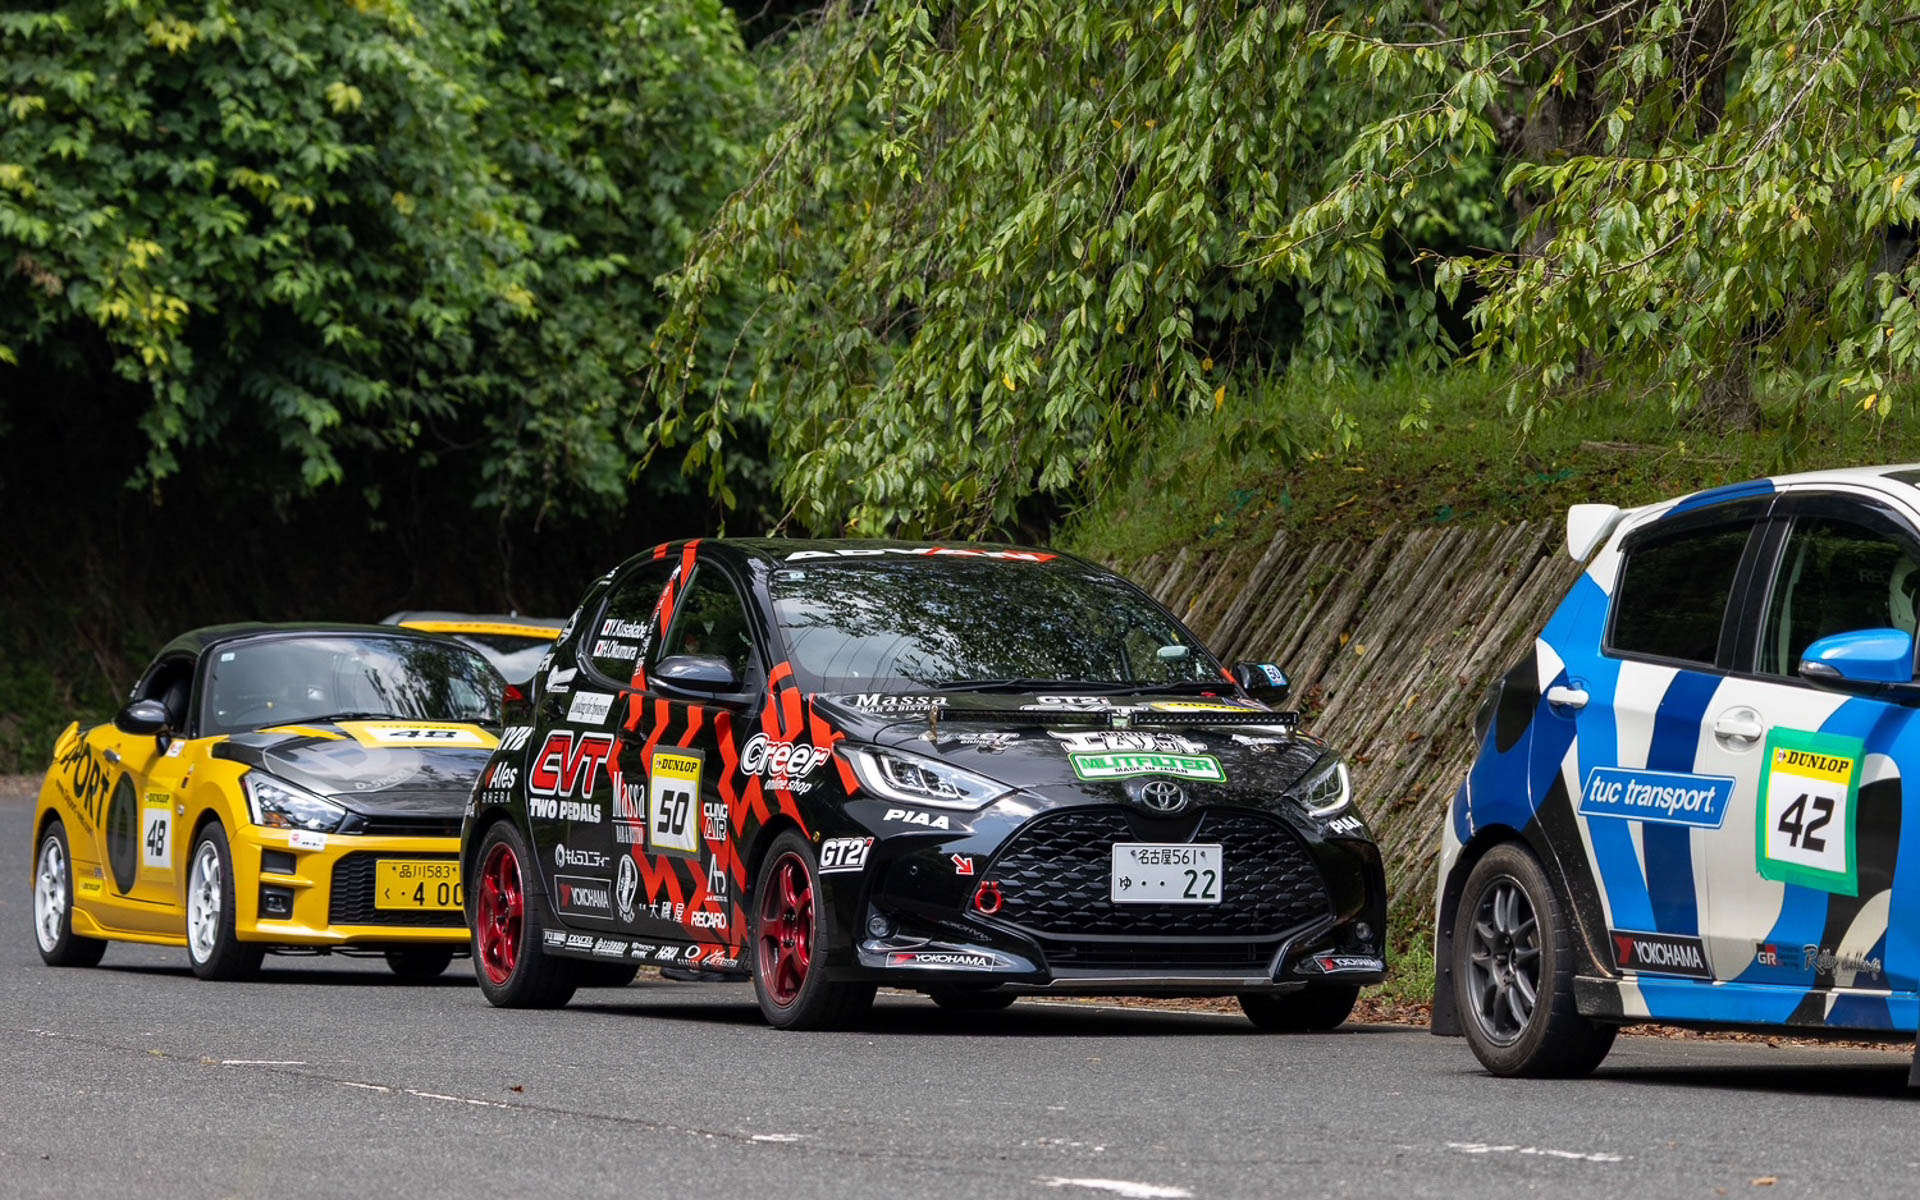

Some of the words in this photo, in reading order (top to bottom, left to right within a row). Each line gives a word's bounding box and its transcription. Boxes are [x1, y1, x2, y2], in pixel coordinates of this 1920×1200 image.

[855, 693, 950, 707] Massa
[661, 758, 698, 773] DUNLOP
[741, 733, 831, 778] Creer
[1787, 751, 1849, 774] DUNLOP
[1158, 766, 1189, 774] JAPAN
[612, 771, 646, 819] Massa
[764, 778, 786, 791] online
[786, 779, 812, 795] shop
[1589, 775, 1622, 803] tuc
[1625, 778, 1716, 816] transport
[529, 798, 557, 819] TWO
[559, 801, 601, 823] PEDALS
[657, 789, 690, 836] 50
[703, 802, 728, 818] CLING
[883, 808, 949, 830] PIAA
[703, 817, 727, 841] AIR
[1778, 793, 1835, 853] 42
[147, 819, 166, 856] 48
[821, 837, 875, 871] GT2i
[1139, 849, 1197, 865] 名古屋561
[399, 865, 450, 878] 品川583
[1183, 869, 1216, 899] 22
[570, 887, 610, 909] YOKOHAMA
[690, 911, 727, 929] RECARO
[915, 954, 987, 967] YOKOHAMA
[1633, 940, 1704, 969] YOKOHAMA
[1757, 951, 1777, 966] GR
